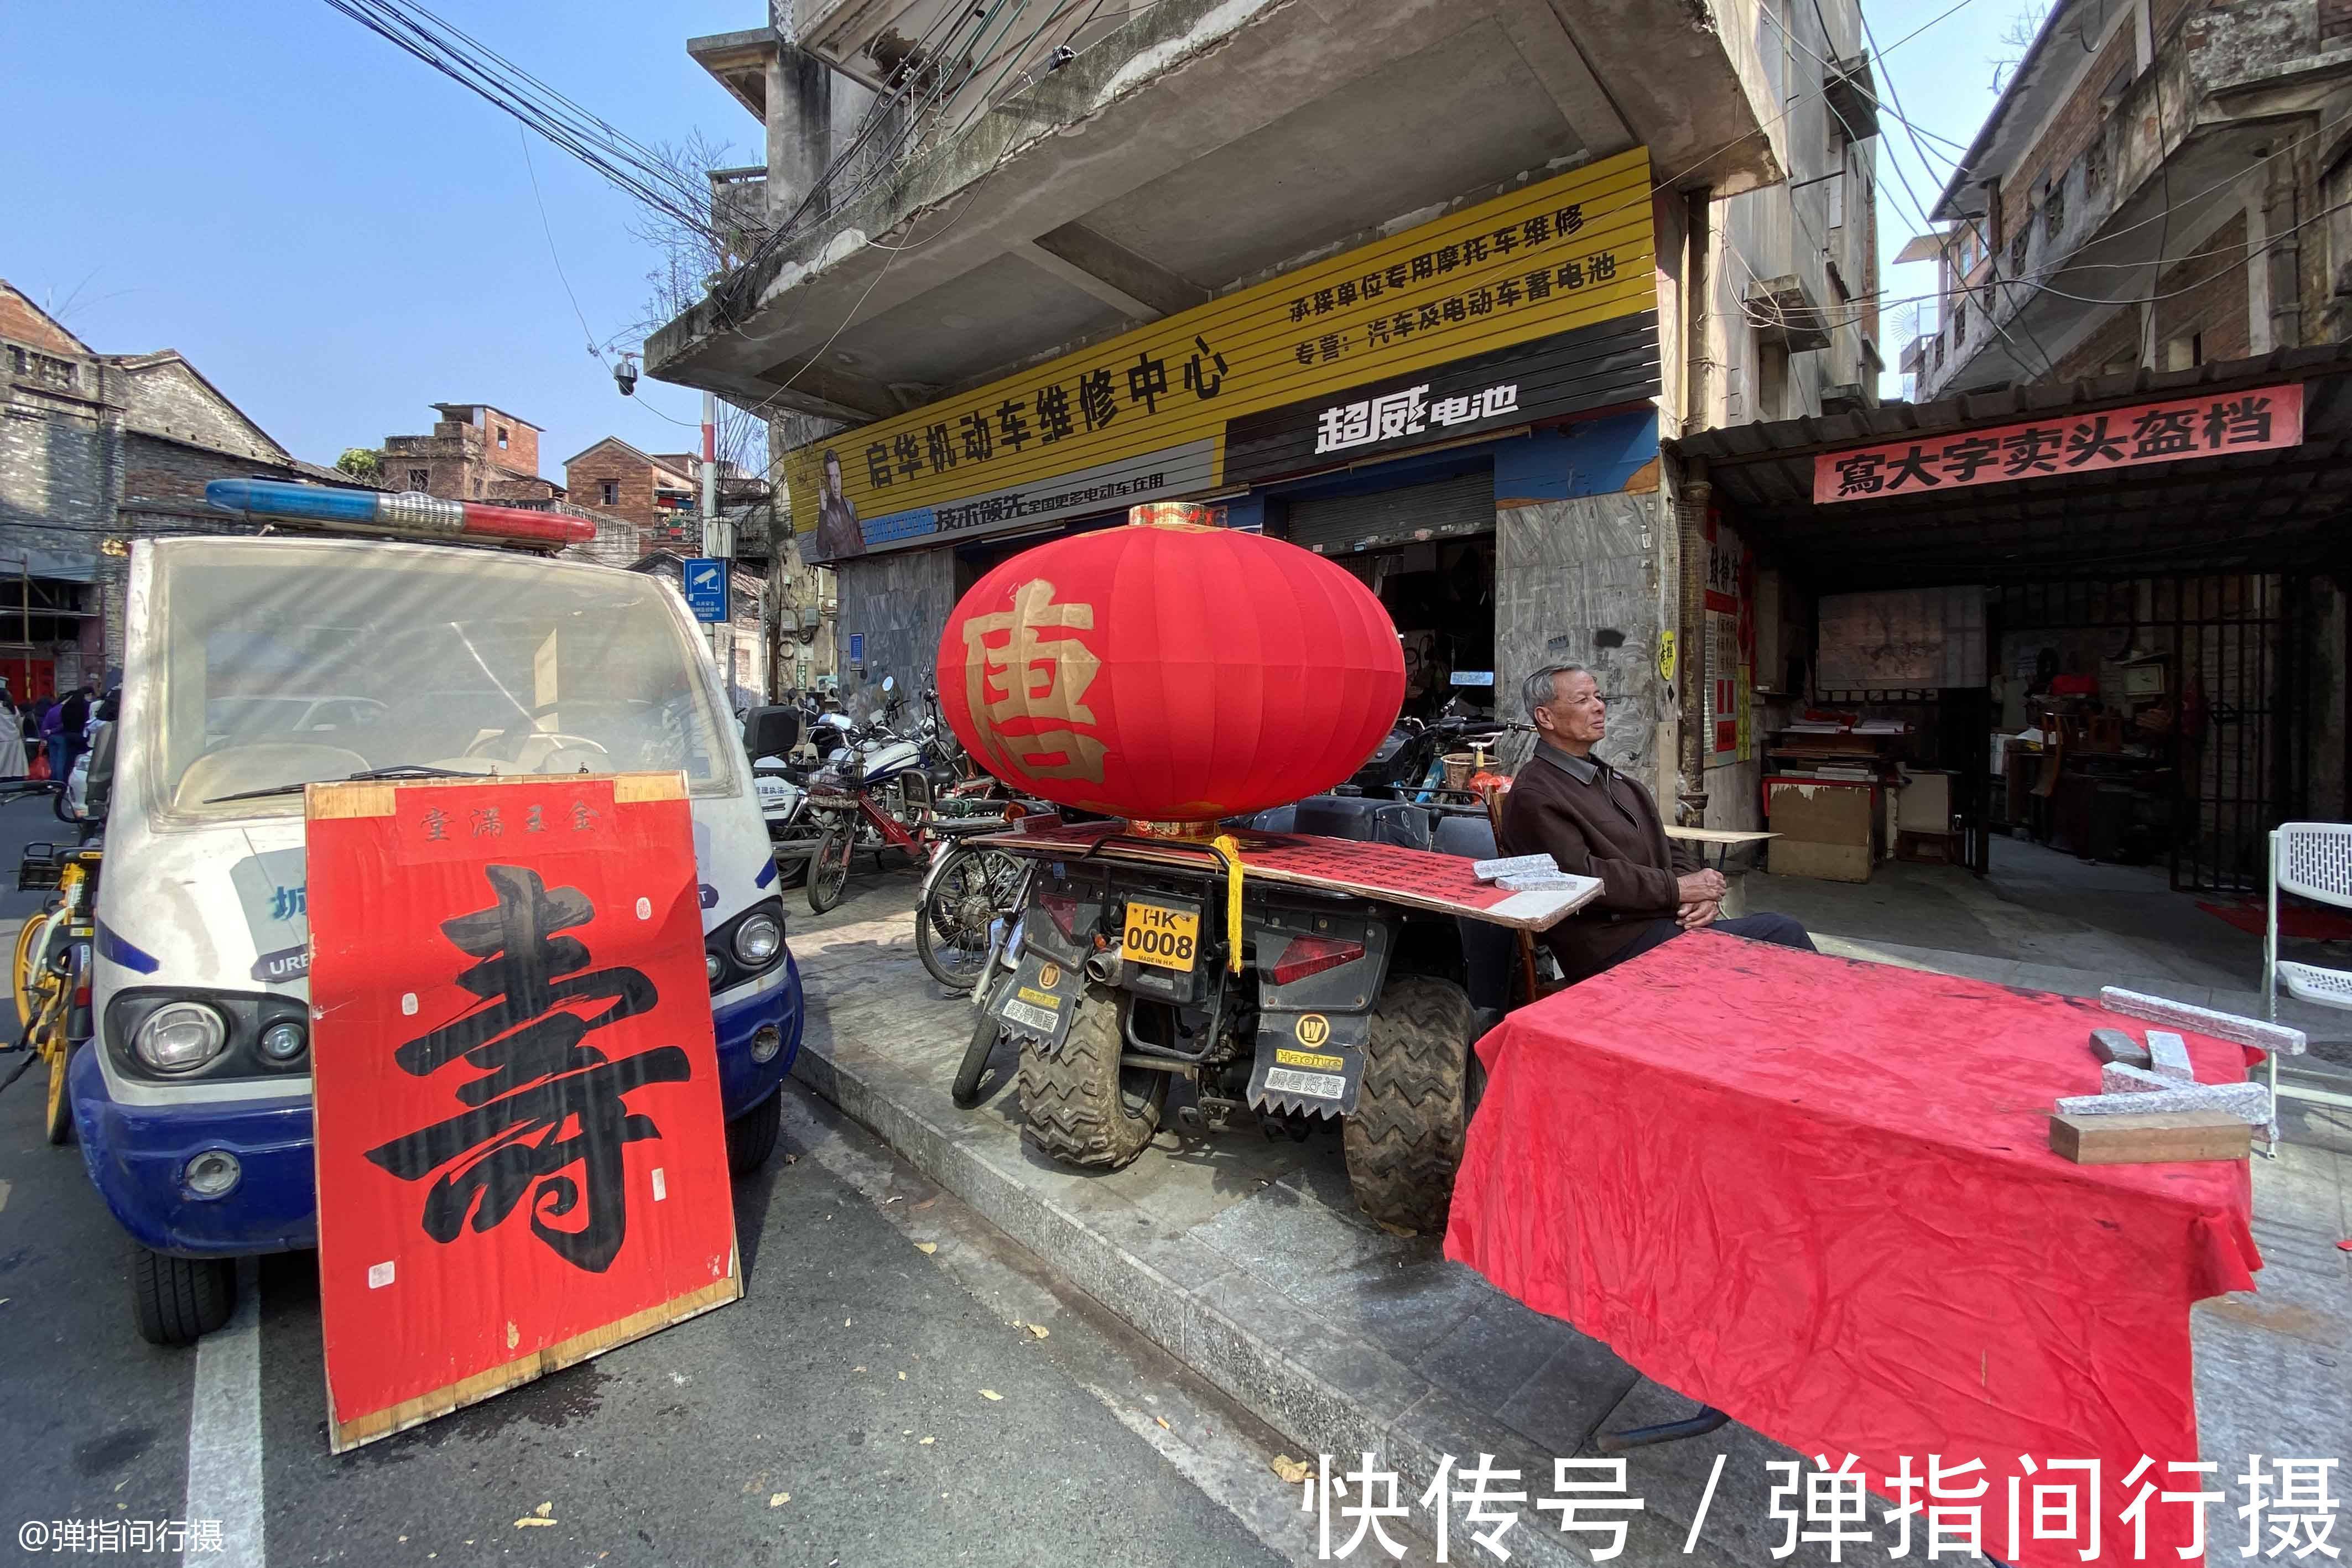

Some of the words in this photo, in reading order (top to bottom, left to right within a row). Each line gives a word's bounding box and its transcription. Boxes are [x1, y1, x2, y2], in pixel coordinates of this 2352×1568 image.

[1291, 204, 1585, 323] 承接单位专用摩托车维修
[866, 335, 1229, 488] 启华机动车维修中心
[1315, 384, 1519, 454] 超威电池
[1143, 909, 1178, 930] HK
[1127, 927, 1193, 959] 0008
[1138, 955, 1154, 963] MADE
[1268, 1070, 1341, 1096] 祝君好运
